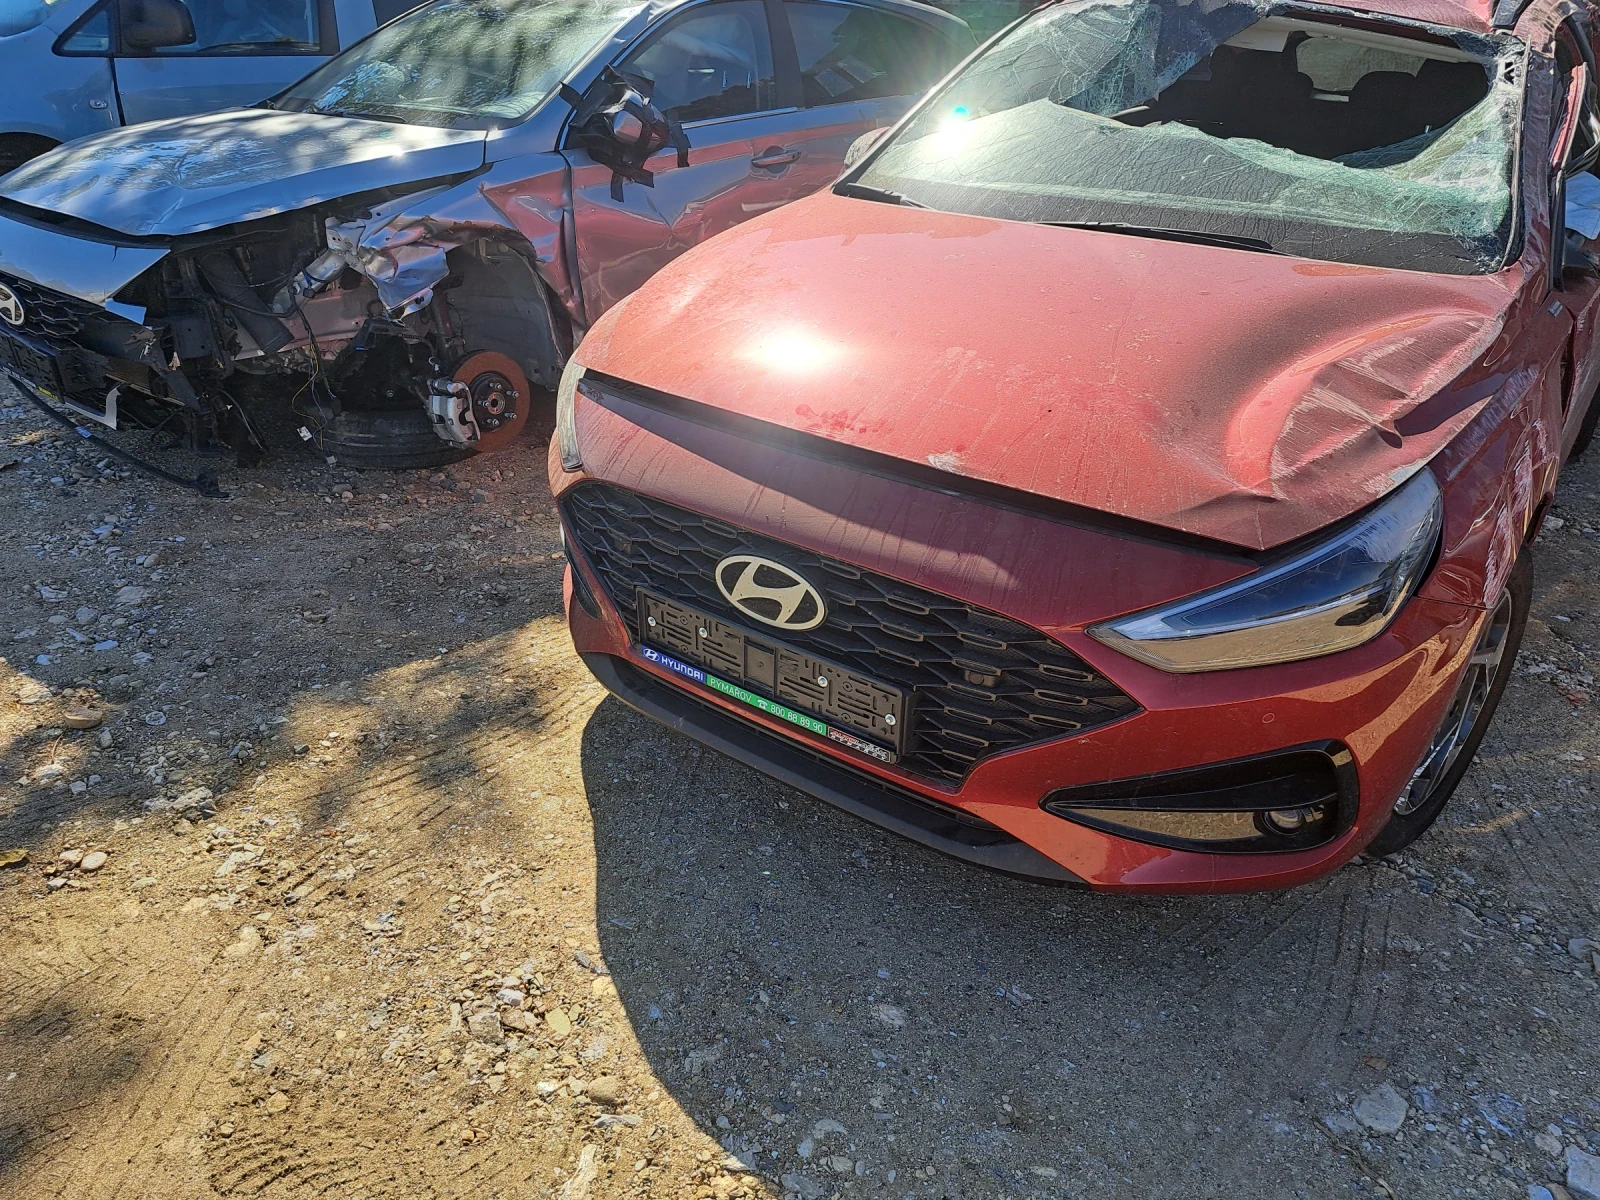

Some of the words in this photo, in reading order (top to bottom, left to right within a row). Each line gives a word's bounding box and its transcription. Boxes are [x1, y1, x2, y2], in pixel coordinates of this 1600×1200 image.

[661, 655, 704, 681] HYUNDAI
[770, 704, 785, 717] 800
[787, 711, 798, 723] 88
[800, 717, 811, 728] 89
[812, 723, 823, 733] 90
